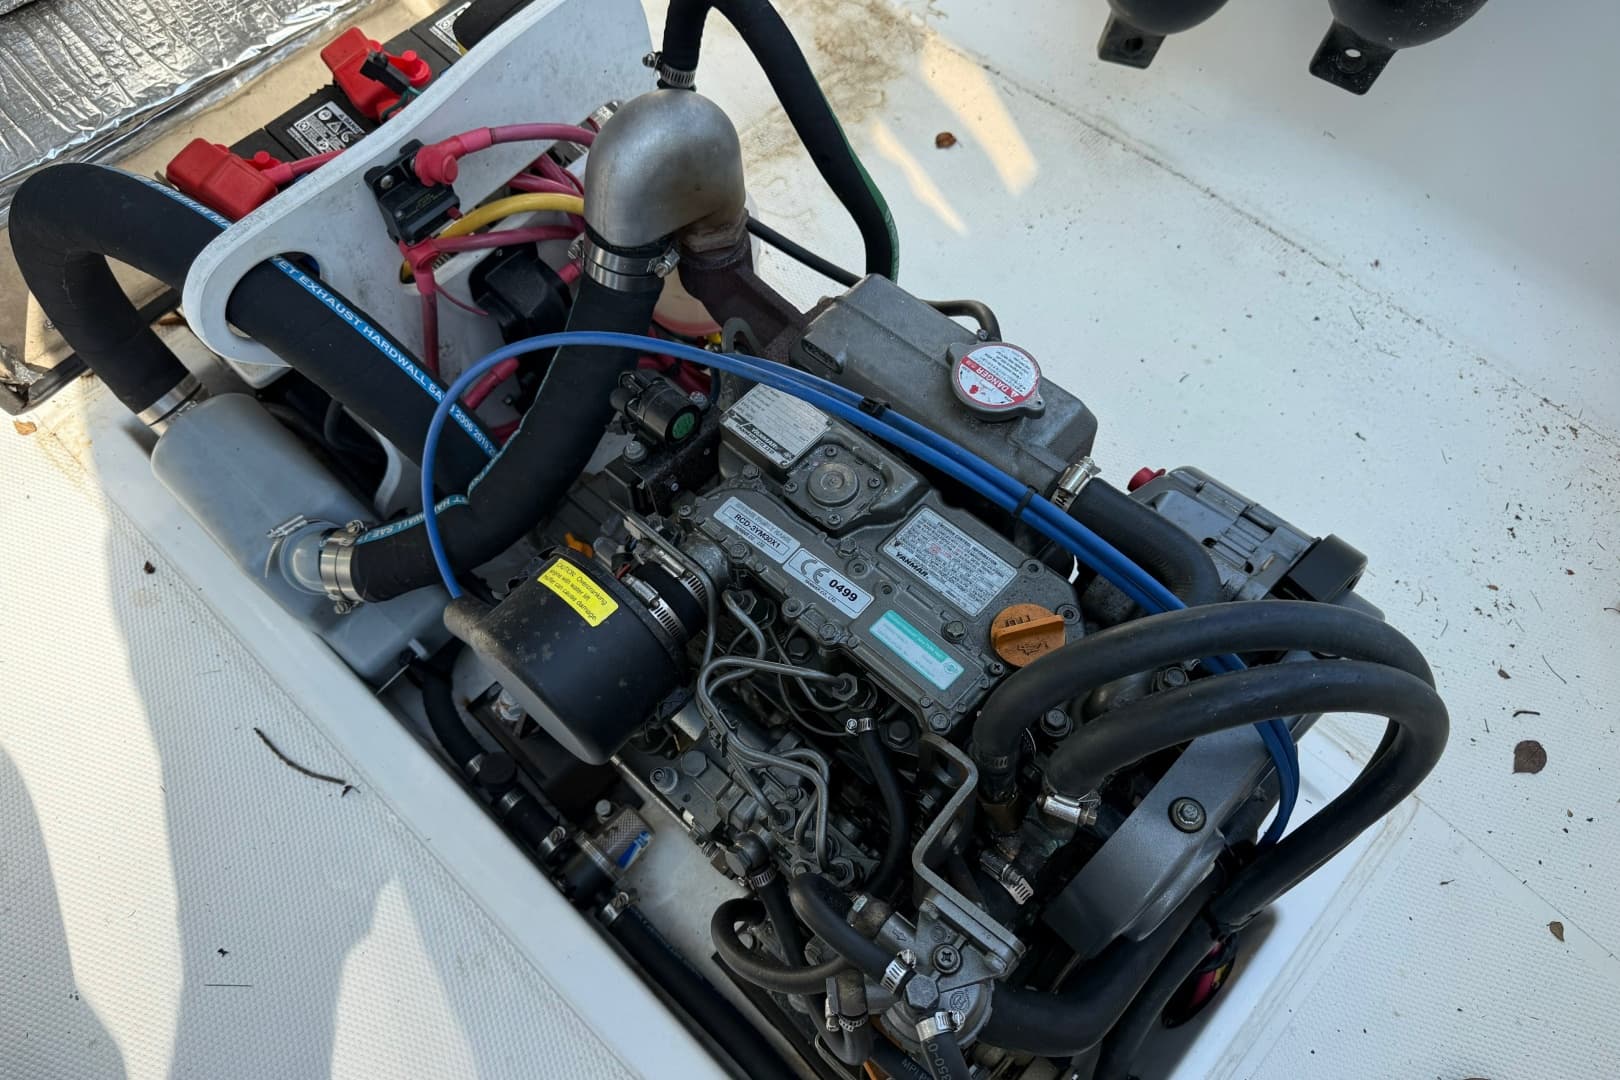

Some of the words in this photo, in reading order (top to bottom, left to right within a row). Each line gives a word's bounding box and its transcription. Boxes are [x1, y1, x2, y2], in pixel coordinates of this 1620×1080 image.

[299, 275, 363, 326] EXHAUST
[362, 326, 427, 386] HARDWALL
[428, 383, 446, 401] SA
[975, 366, 1009, 392] DANGER
[734, 513, 781, 549] RCD-3YM30X1
[828, 579, 858, 602] 0499
